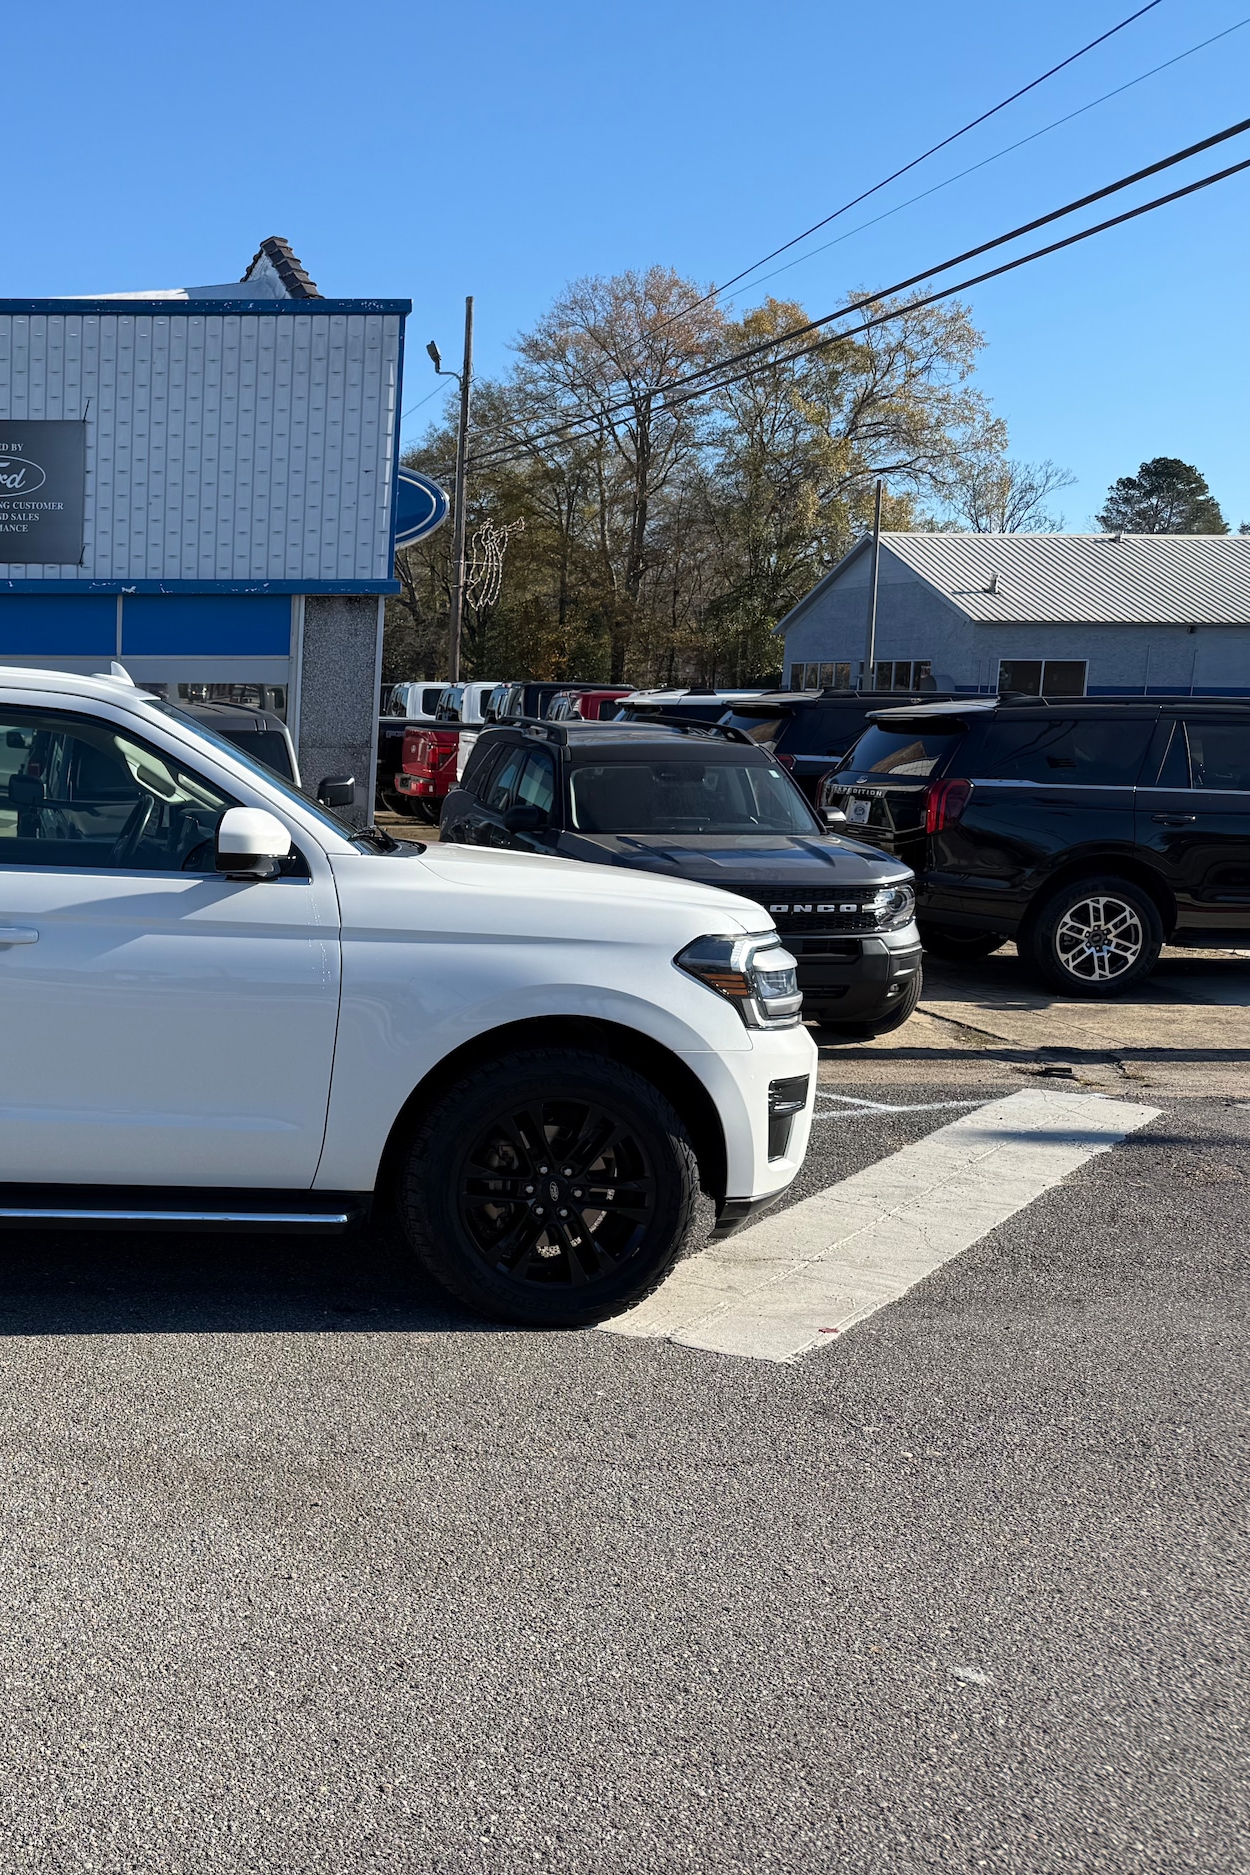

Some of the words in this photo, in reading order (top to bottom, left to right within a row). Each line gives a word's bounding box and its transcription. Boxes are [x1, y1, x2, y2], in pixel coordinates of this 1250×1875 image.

[11, 443, 24, 452] BY
[12, 501, 64, 511] CUSTOMER
[10, 513, 40, 522] SALES
[769, 904, 858, 913] ONCO
